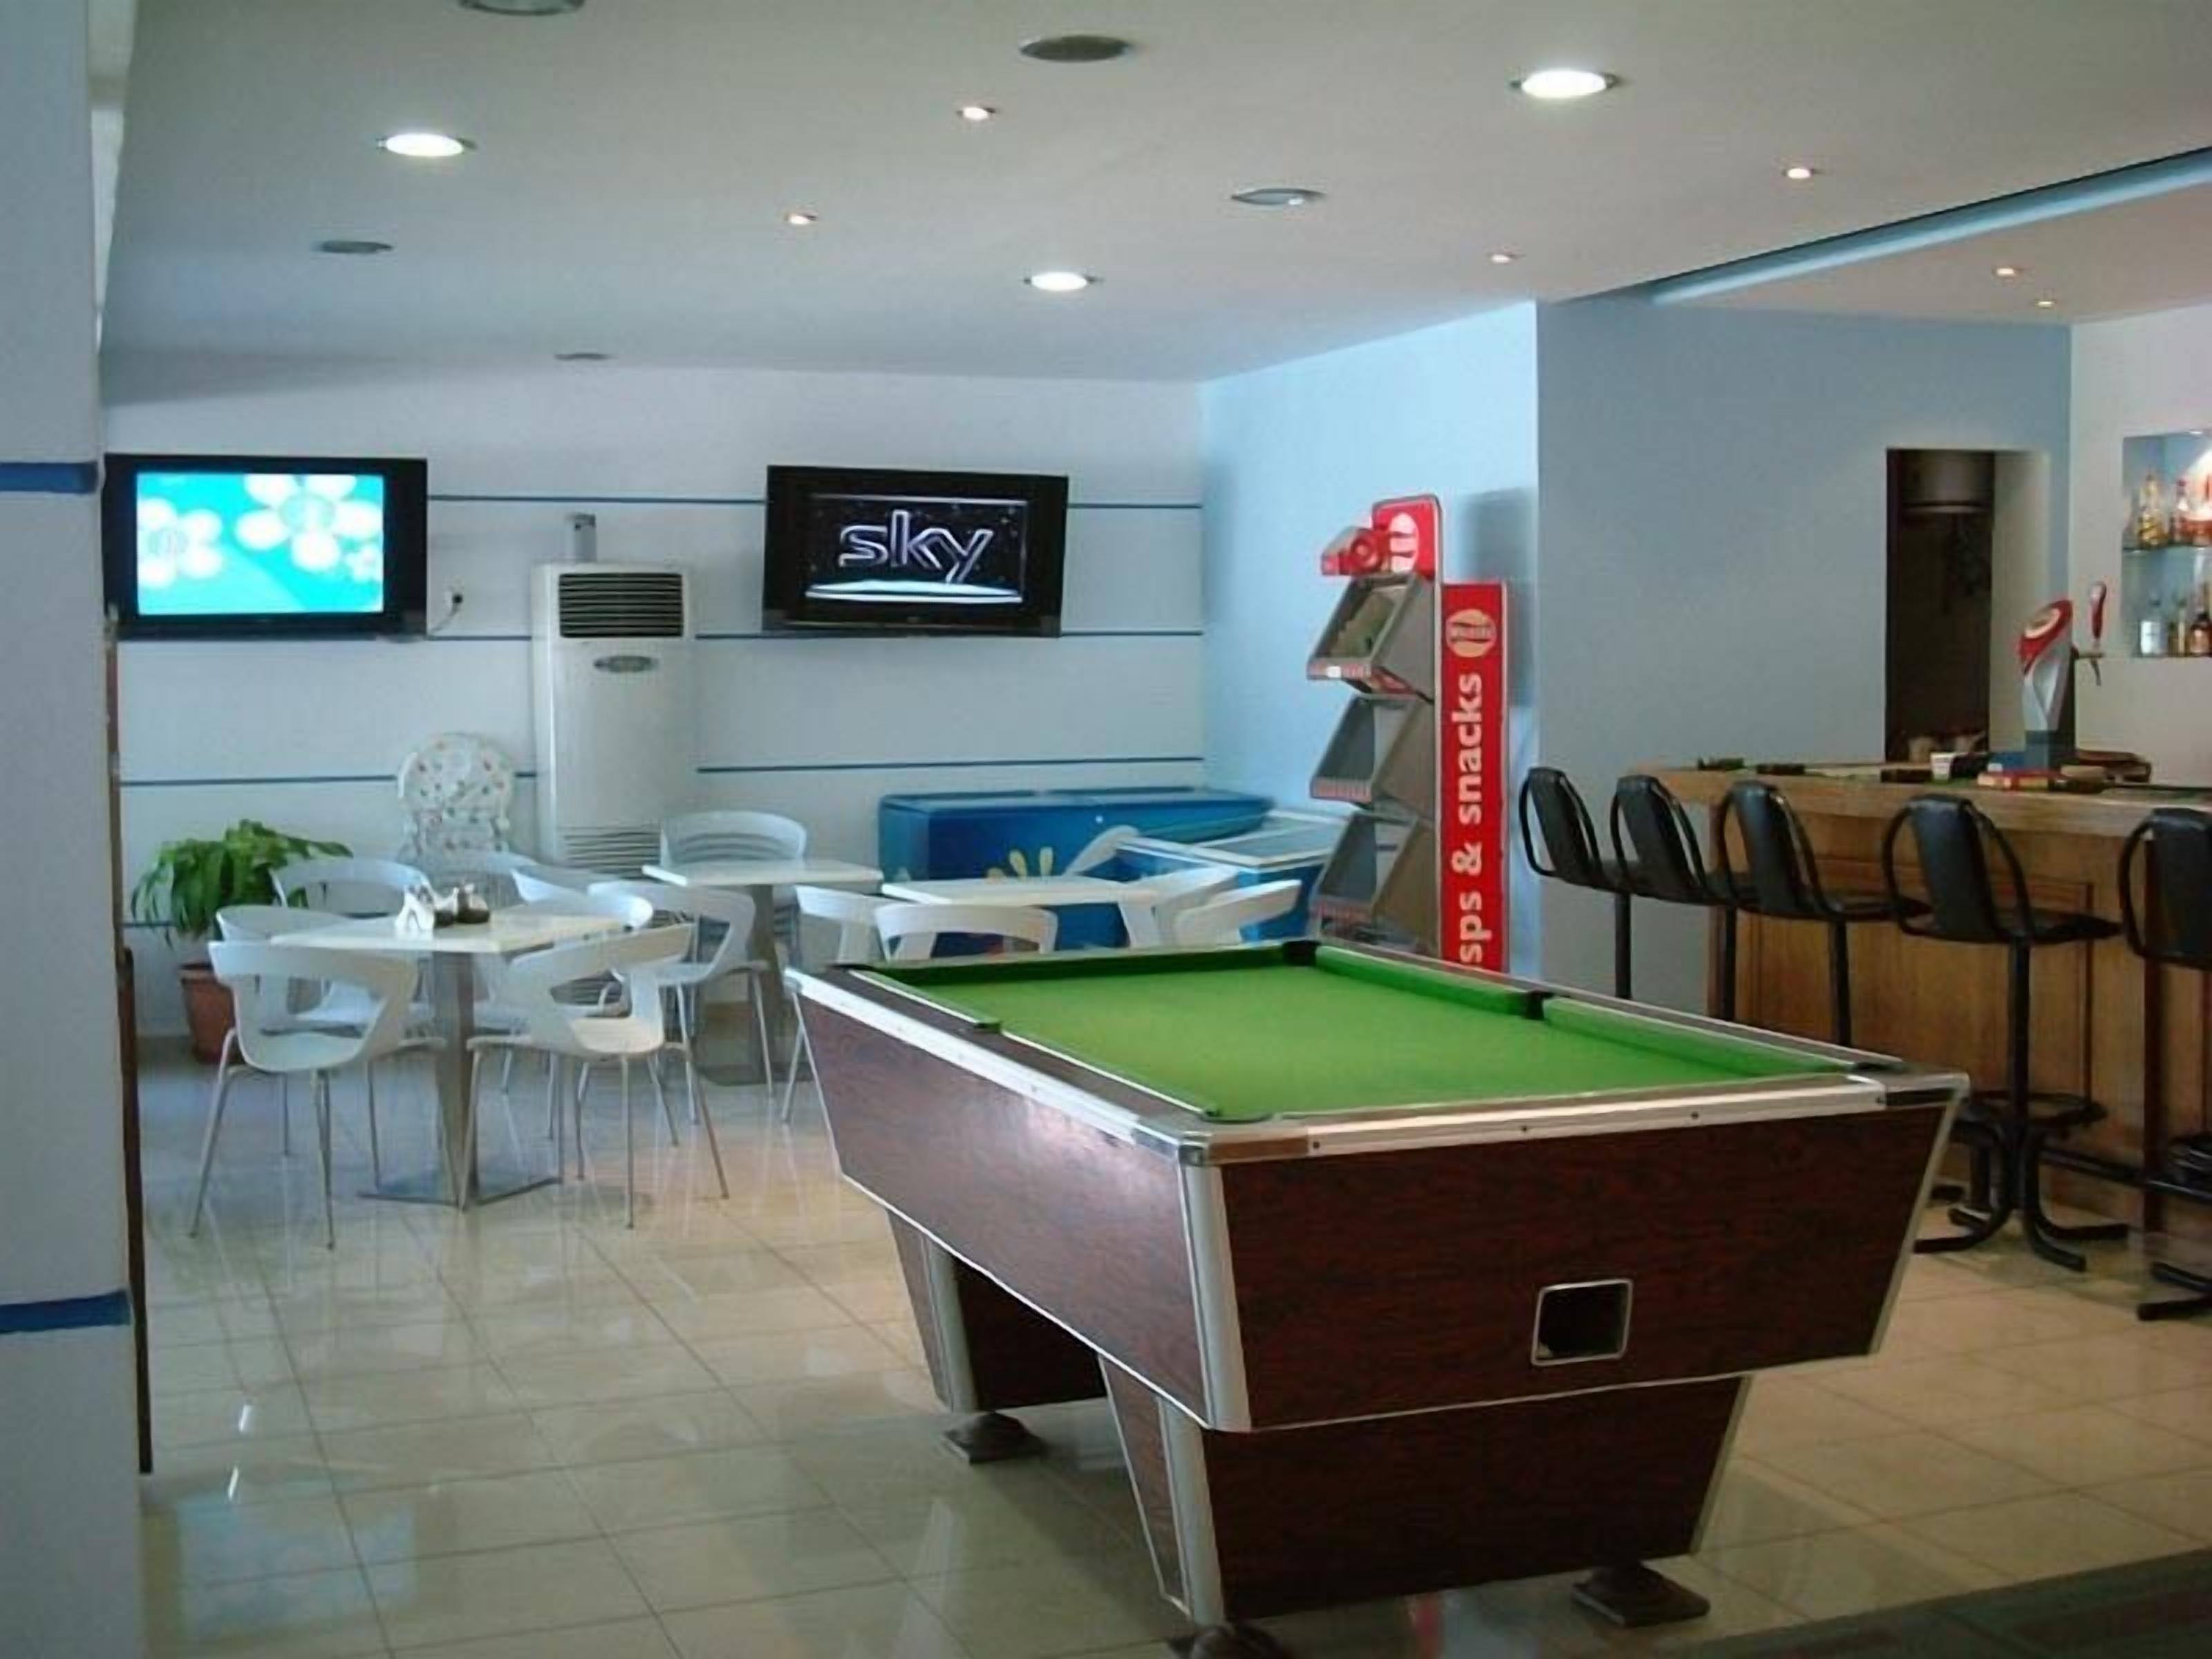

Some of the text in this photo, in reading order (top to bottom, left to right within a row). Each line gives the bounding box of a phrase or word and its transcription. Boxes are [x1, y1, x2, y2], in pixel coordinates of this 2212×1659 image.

[838, 509, 994, 583] sky
[1451, 672, 1483, 825] snacks
[1451, 841, 1483, 877] &
